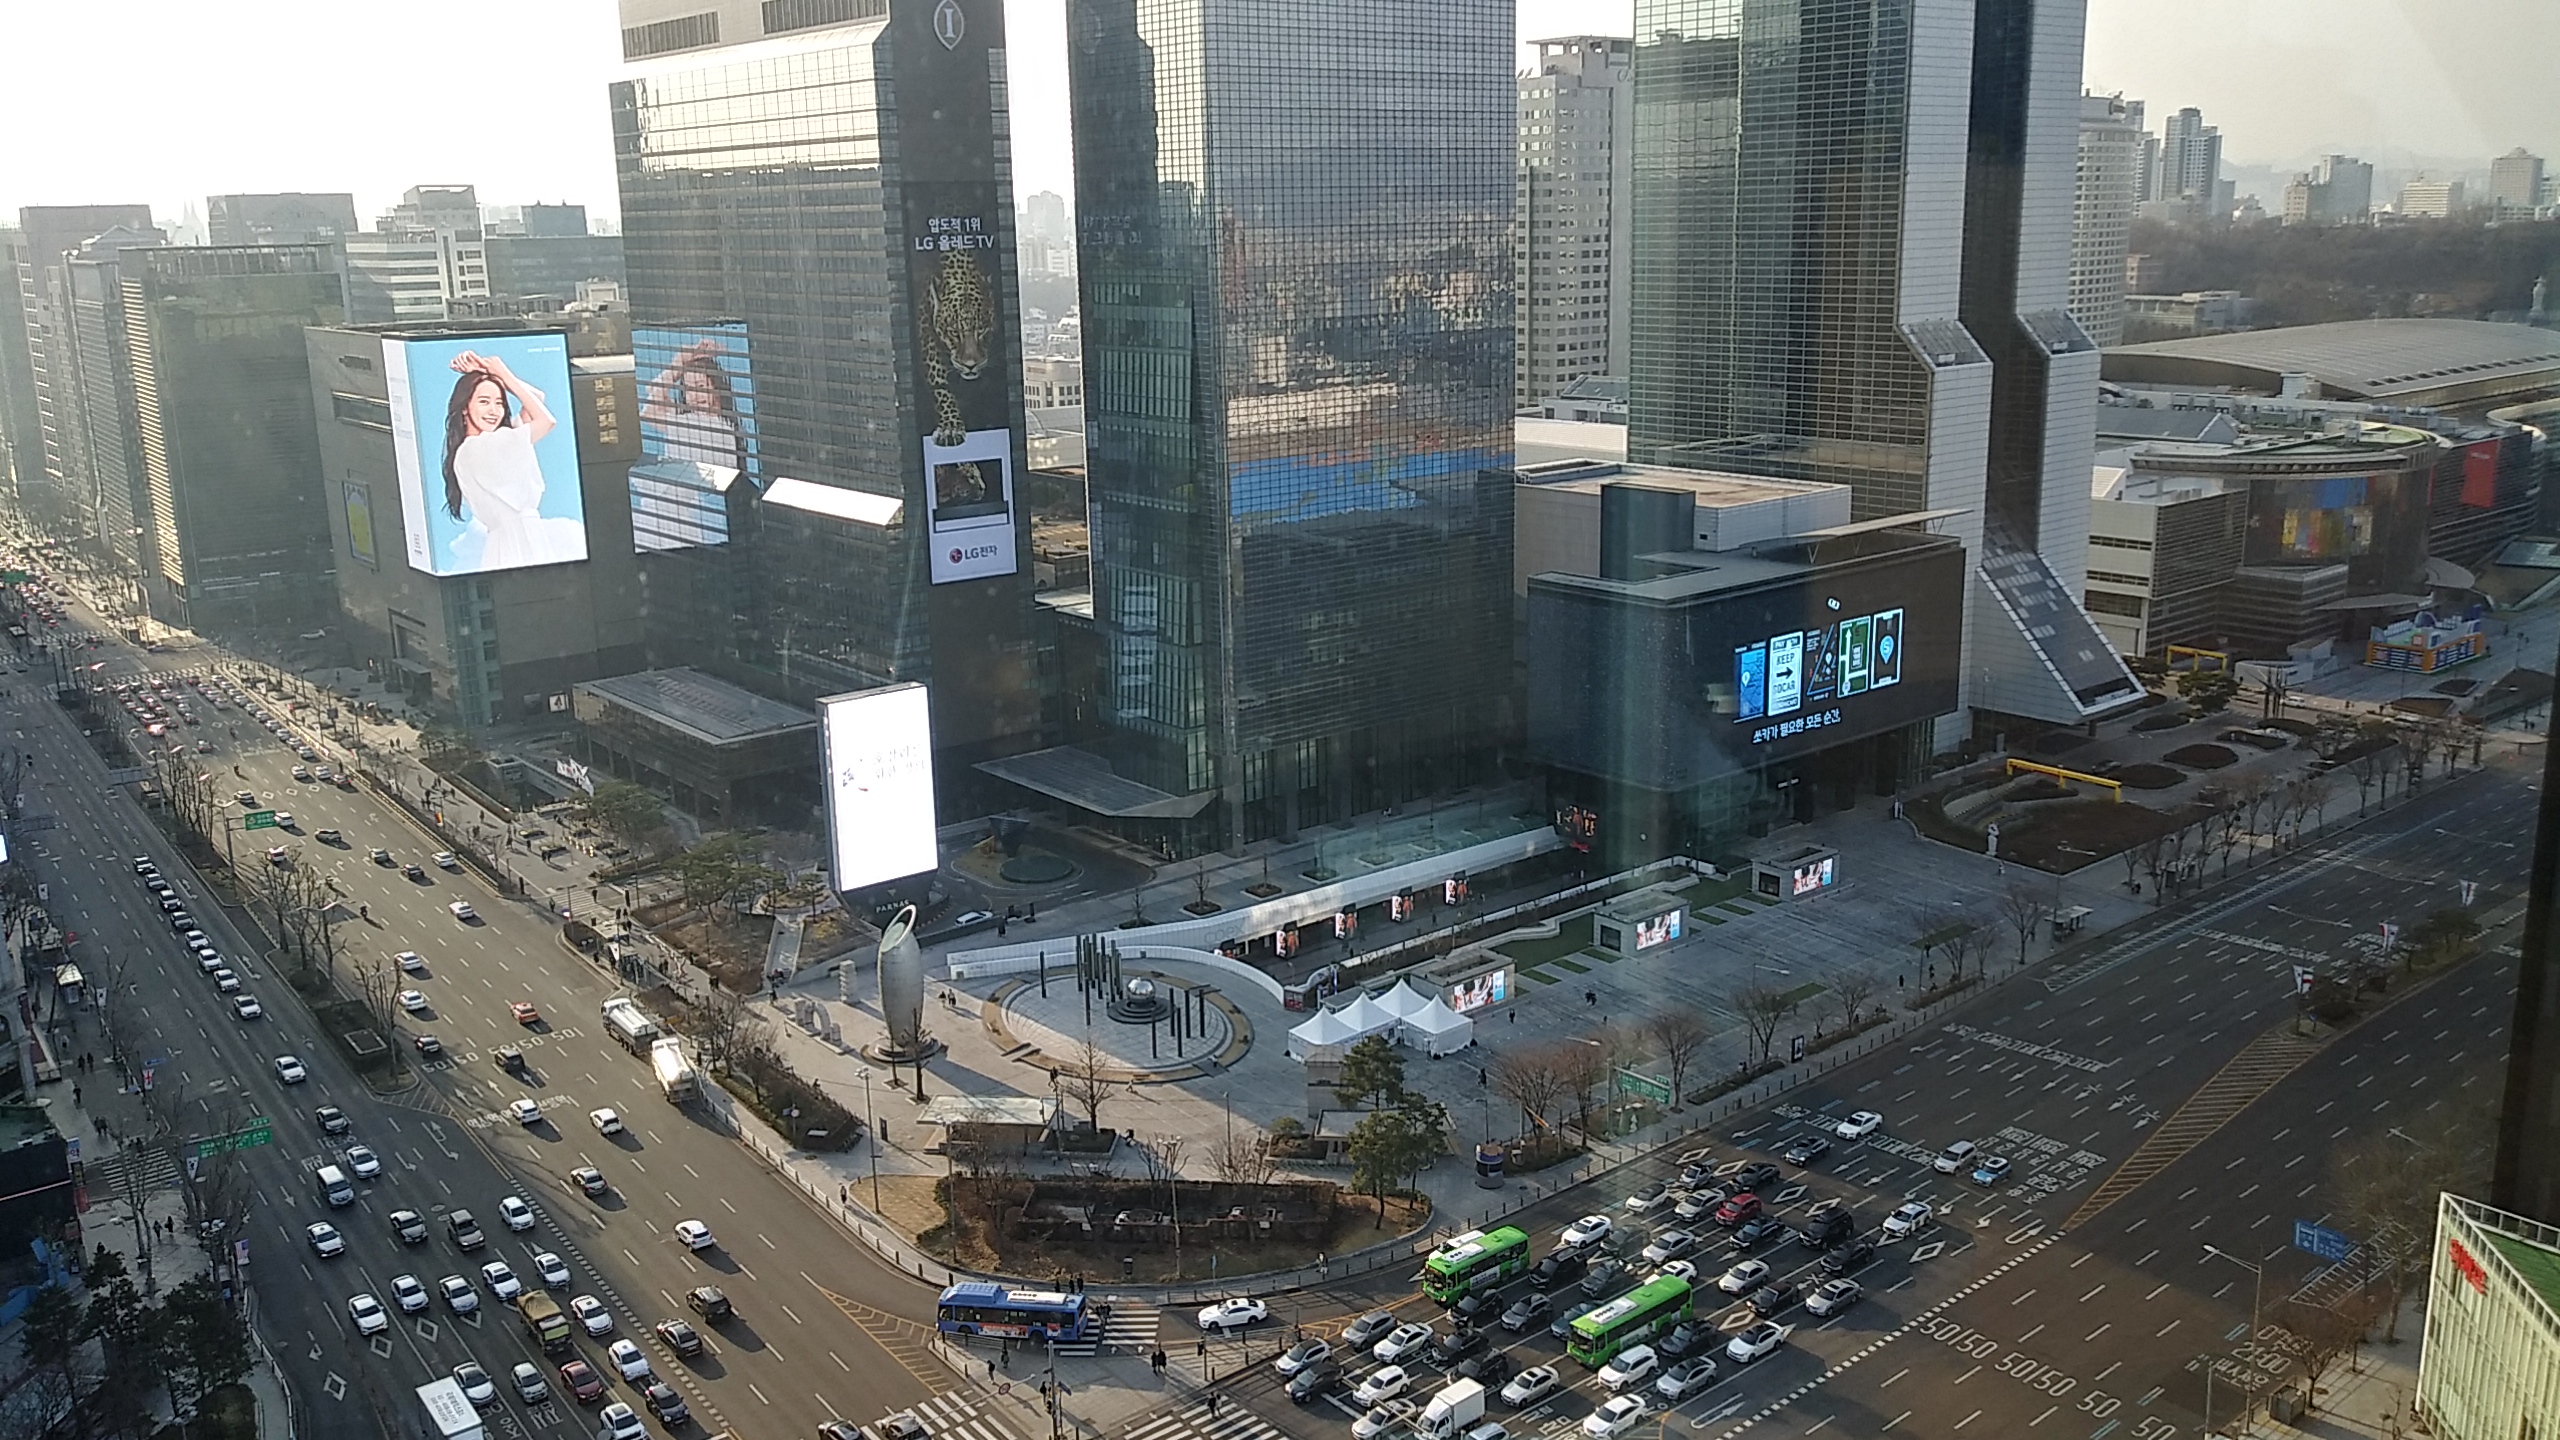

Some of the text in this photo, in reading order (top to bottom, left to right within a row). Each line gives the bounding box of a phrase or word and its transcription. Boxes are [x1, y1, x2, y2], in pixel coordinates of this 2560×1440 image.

[928, 217, 982, 233] 압도적 1위
[915, 234, 995, 251] LG 올레드 TV
[964, 545, 998, 560] LG전자
[1776, 652, 1796, 666] KEEP
[1752, 724, 1779, 744] 쏘카가
[1780, 717, 1805, 737] 필요한
[1805, 713, 1823, 729] 모든
[1204, 916, 1246, 945] coex
[422, 1060, 448, 1074] 50
[454, 1052, 480, 1065] 50
[519, 1036, 545, 1050] 50
[550, 1028, 576, 1042] 50
[1919, 1315, 2178, 1440] 50 50 50 50 50 50
